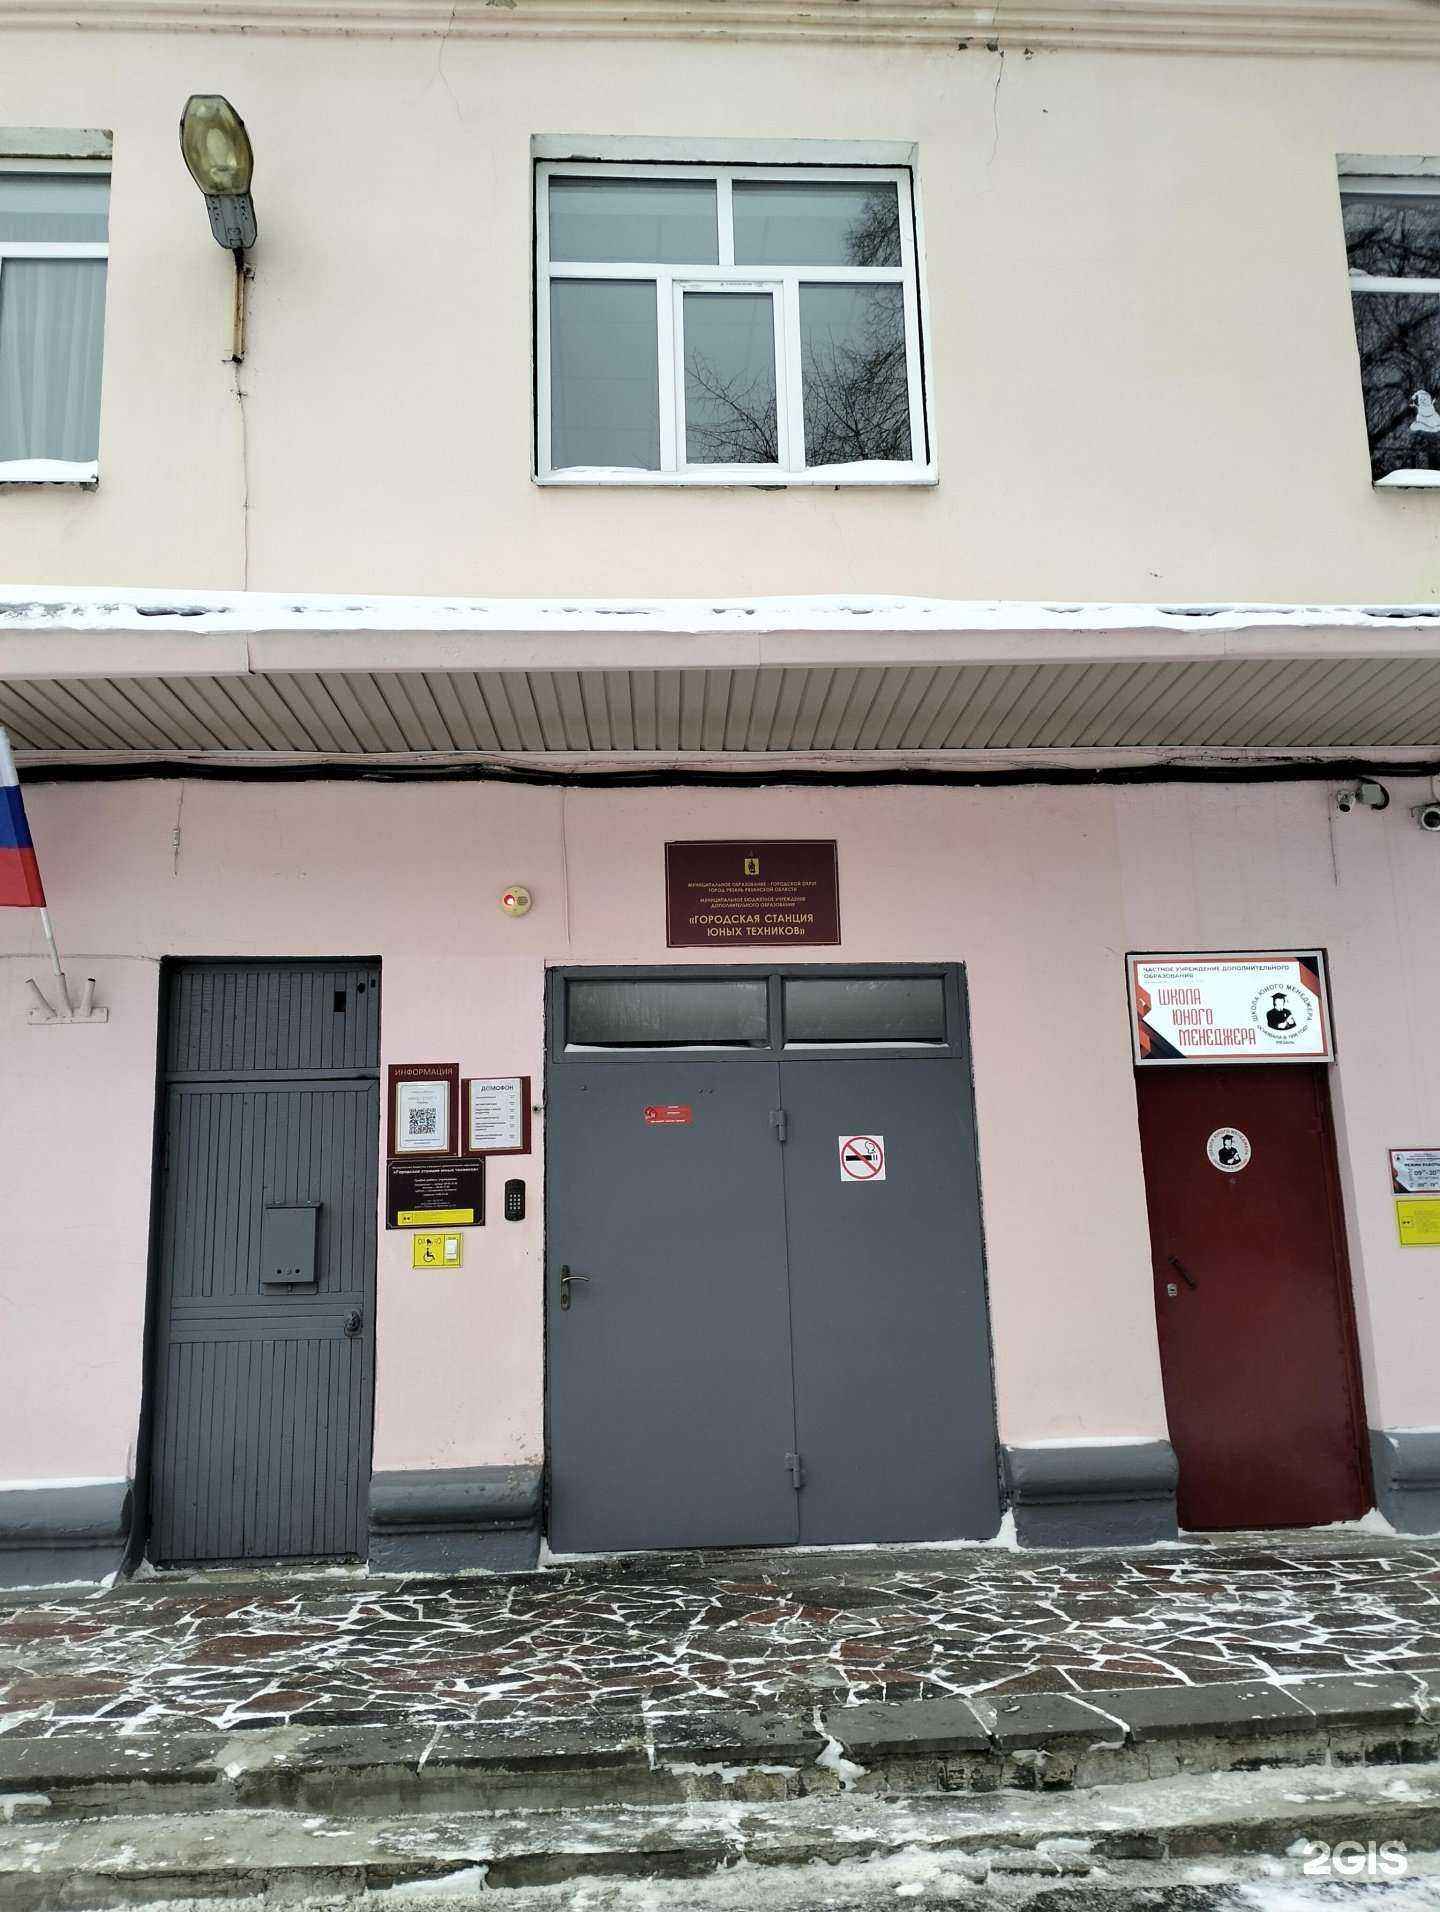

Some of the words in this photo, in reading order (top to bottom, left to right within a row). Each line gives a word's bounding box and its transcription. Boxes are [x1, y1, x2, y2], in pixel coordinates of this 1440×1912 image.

[689, 914, 760, 925] «ГОРОДСКАЯ
[764, 913, 814, 924] СТАНЦИЯ
[707, 927, 743, 937] ЮНЫХ
[746, 926, 805, 936] ТЕХНИКОВ»
[1158, 988, 1201, 1006] ШКОЛА
[1172, 1008, 1213, 1026] ЮНОГО
[1178, 1028, 1257, 1047] МЕНЕДЖЕРА
[394, 1067, 453, 1076] ИНФОРМАЦИЯ
[481, 1084, 514, 1092] ДОМОФОН
